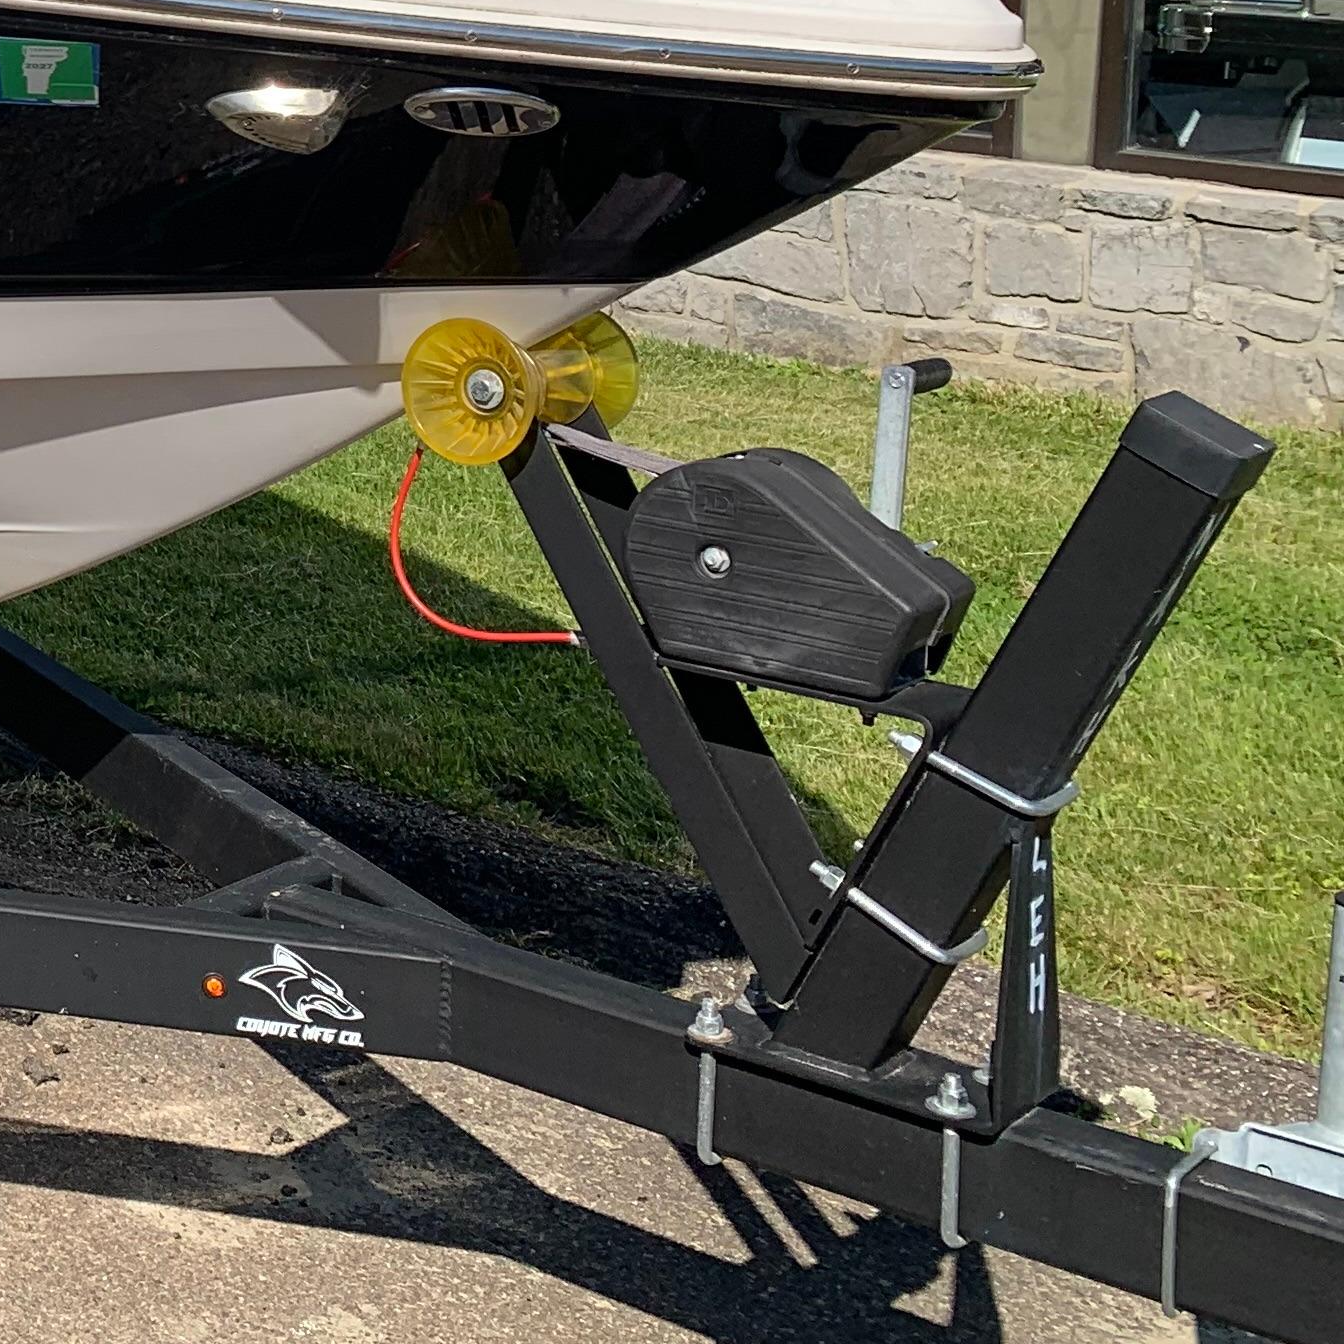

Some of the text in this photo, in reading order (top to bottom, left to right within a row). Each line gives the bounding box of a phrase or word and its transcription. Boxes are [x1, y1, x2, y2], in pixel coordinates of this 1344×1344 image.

[236, 1016, 365, 1048] COYOTE MFG CO.
